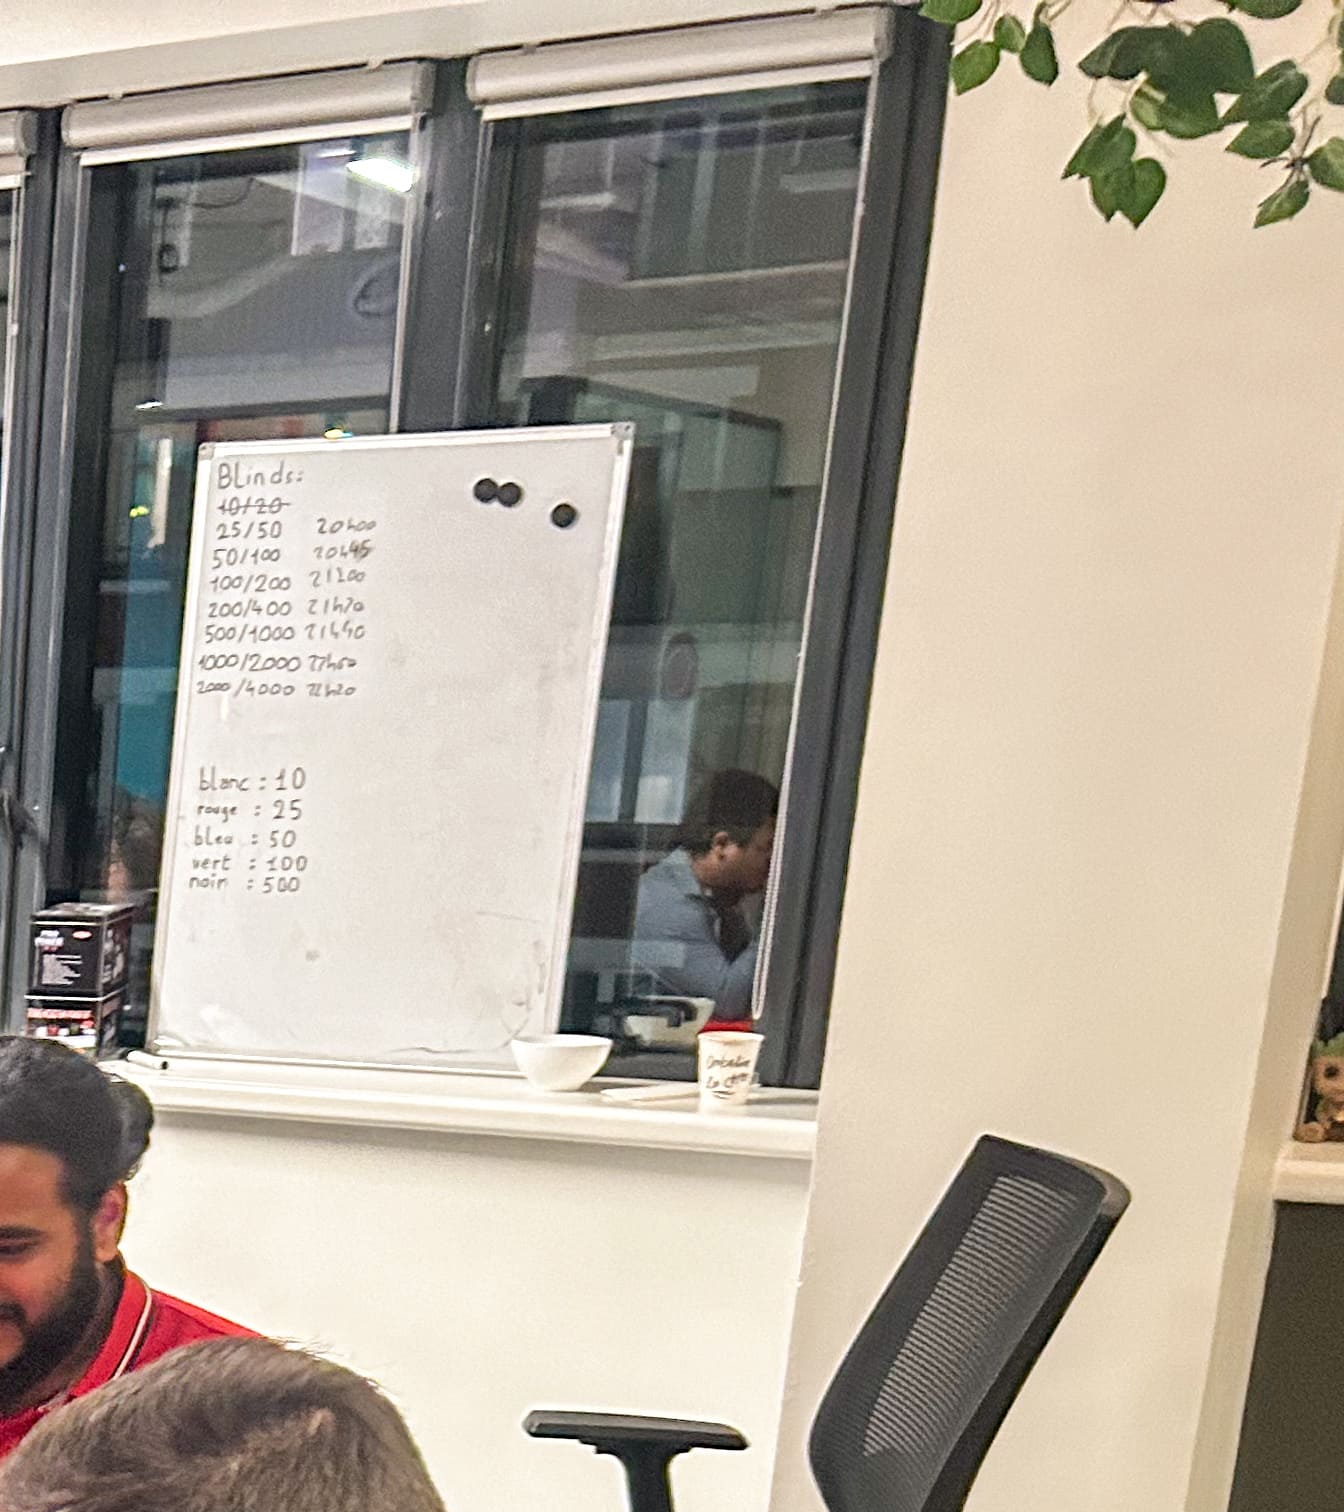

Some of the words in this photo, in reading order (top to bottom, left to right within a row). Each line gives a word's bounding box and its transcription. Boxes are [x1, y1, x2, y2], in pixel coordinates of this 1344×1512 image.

[216, 520, 283, 540] 25/50
[212, 548, 281, 569] 50/100
[210, 574, 291, 593] 100/200
[208, 598, 292, 618] 200/400
[205, 624, 295, 643] 500/1000
[198, 653, 301, 672] 1000/2000
[199, 766, 249, 791] blanc
[275, 767, 306, 790] 10
[197, 804, 238, 823] rouge
[272, 799, 302, 820] 25
[269, 830, 297, 848] 50
[192, 854, 231, 871] vert
[266, 855, 308, 872] 100
[189, 873, 227, 889] noir
[262, 876, 301, 893] 500
